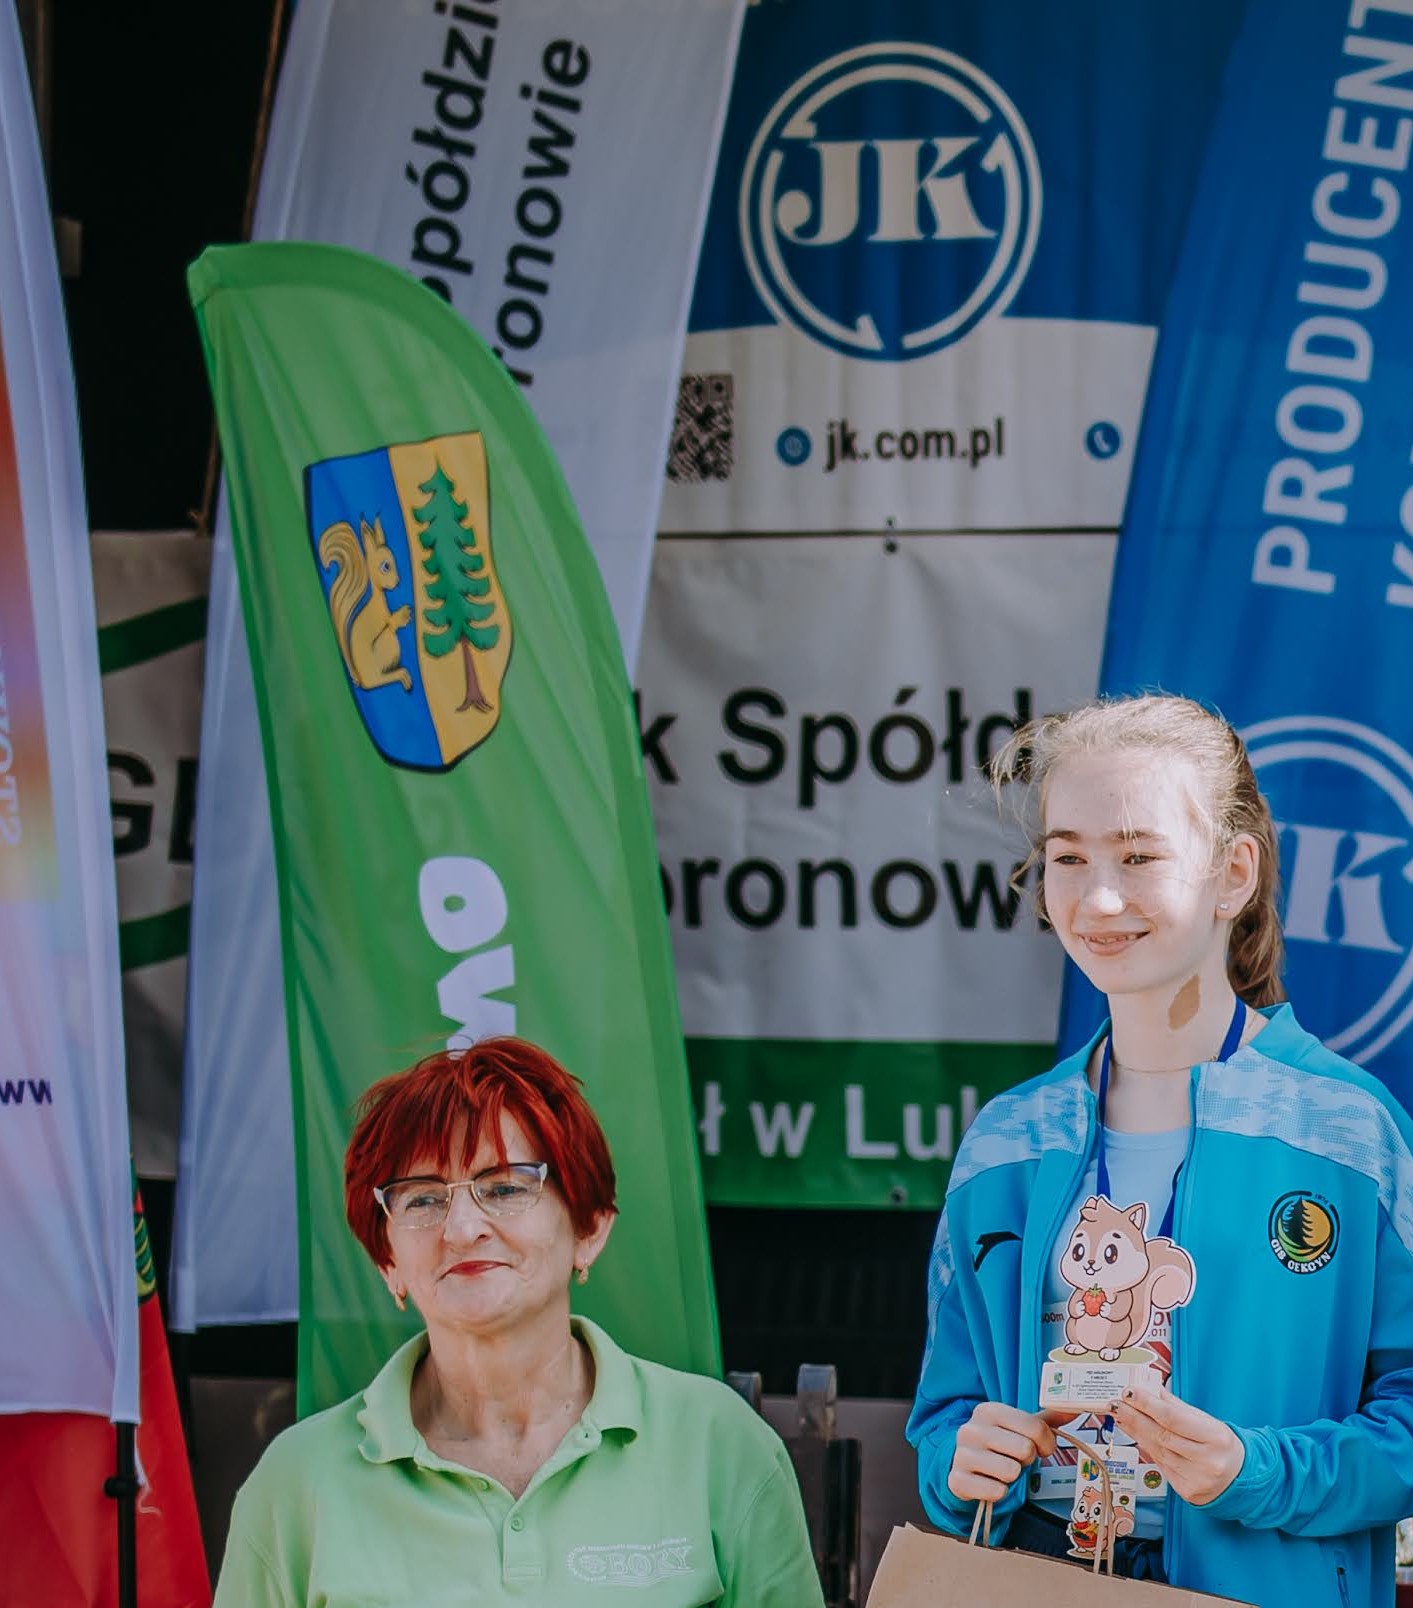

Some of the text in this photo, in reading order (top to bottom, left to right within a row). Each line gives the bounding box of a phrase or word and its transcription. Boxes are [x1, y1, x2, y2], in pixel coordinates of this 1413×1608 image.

[777, 136, 998, 246] JK
[824, 416, 1004, 472] jk.com.pl
[750, 1101, 815, 1157] w
